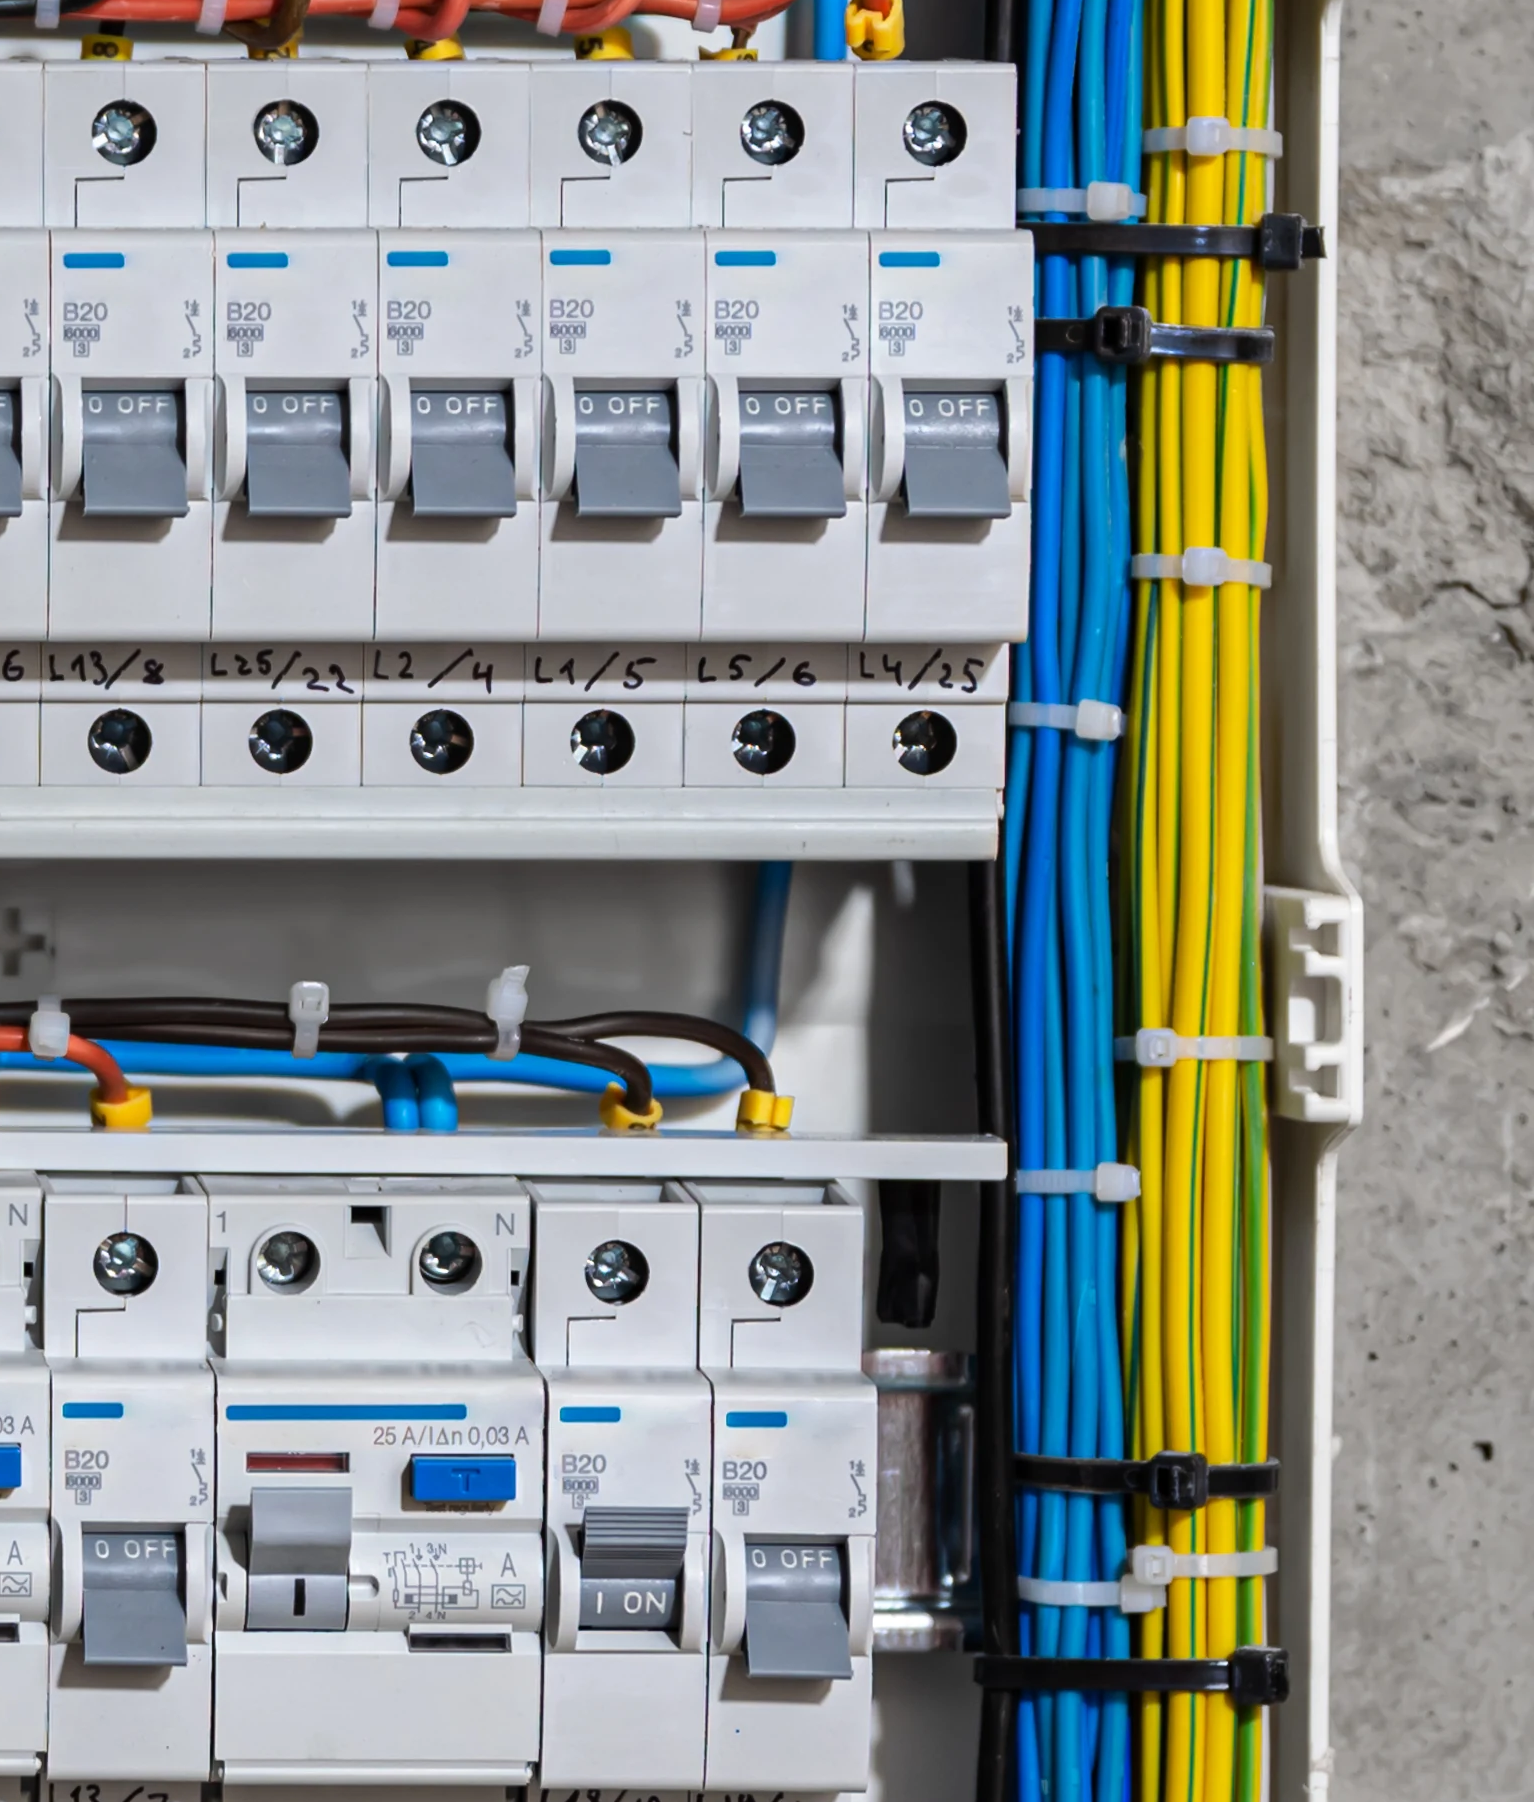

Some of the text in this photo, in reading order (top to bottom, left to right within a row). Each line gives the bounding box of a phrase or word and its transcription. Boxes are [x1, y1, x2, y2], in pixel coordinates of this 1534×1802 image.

[63, 302, 108, 322] B20
[227, 302, 272, 322] B20
[386, 301, 432, 320] B20
[549, 300, 595, 319] B20
[714, 300, 760, 320] B20
[878, 301, 924, 320] B20
[117, 396, 171, 414] OFF
[282, 396, 335, 414] OFF
[445, 396, 499, 415] OFF
[608, 396, 662, 415] OFF
[774, 396, 828, 415] OFF
[938, 398, 991, 417] OFF
[8, 1203, 28, 1226] N
[216, 1211, 227, 1233] 1
[496, 1213, 516, 1236] N
[19, 1416, 35, 1435] A
[373, 1426, 397, 1446] 25
[467, 1426, 510, 1448] 0,03
[514, 1426, 530, 1446] A
[64, 1449, 110, 1470] B20
[561, 1454, 607, 1475] B20
[722, 1461, 768, 1481] B20
[124, 1539, 177, 1559] OFF
[781, 1549, 833, 1569] OFF
[623, 1591, 667, 1615] ON
